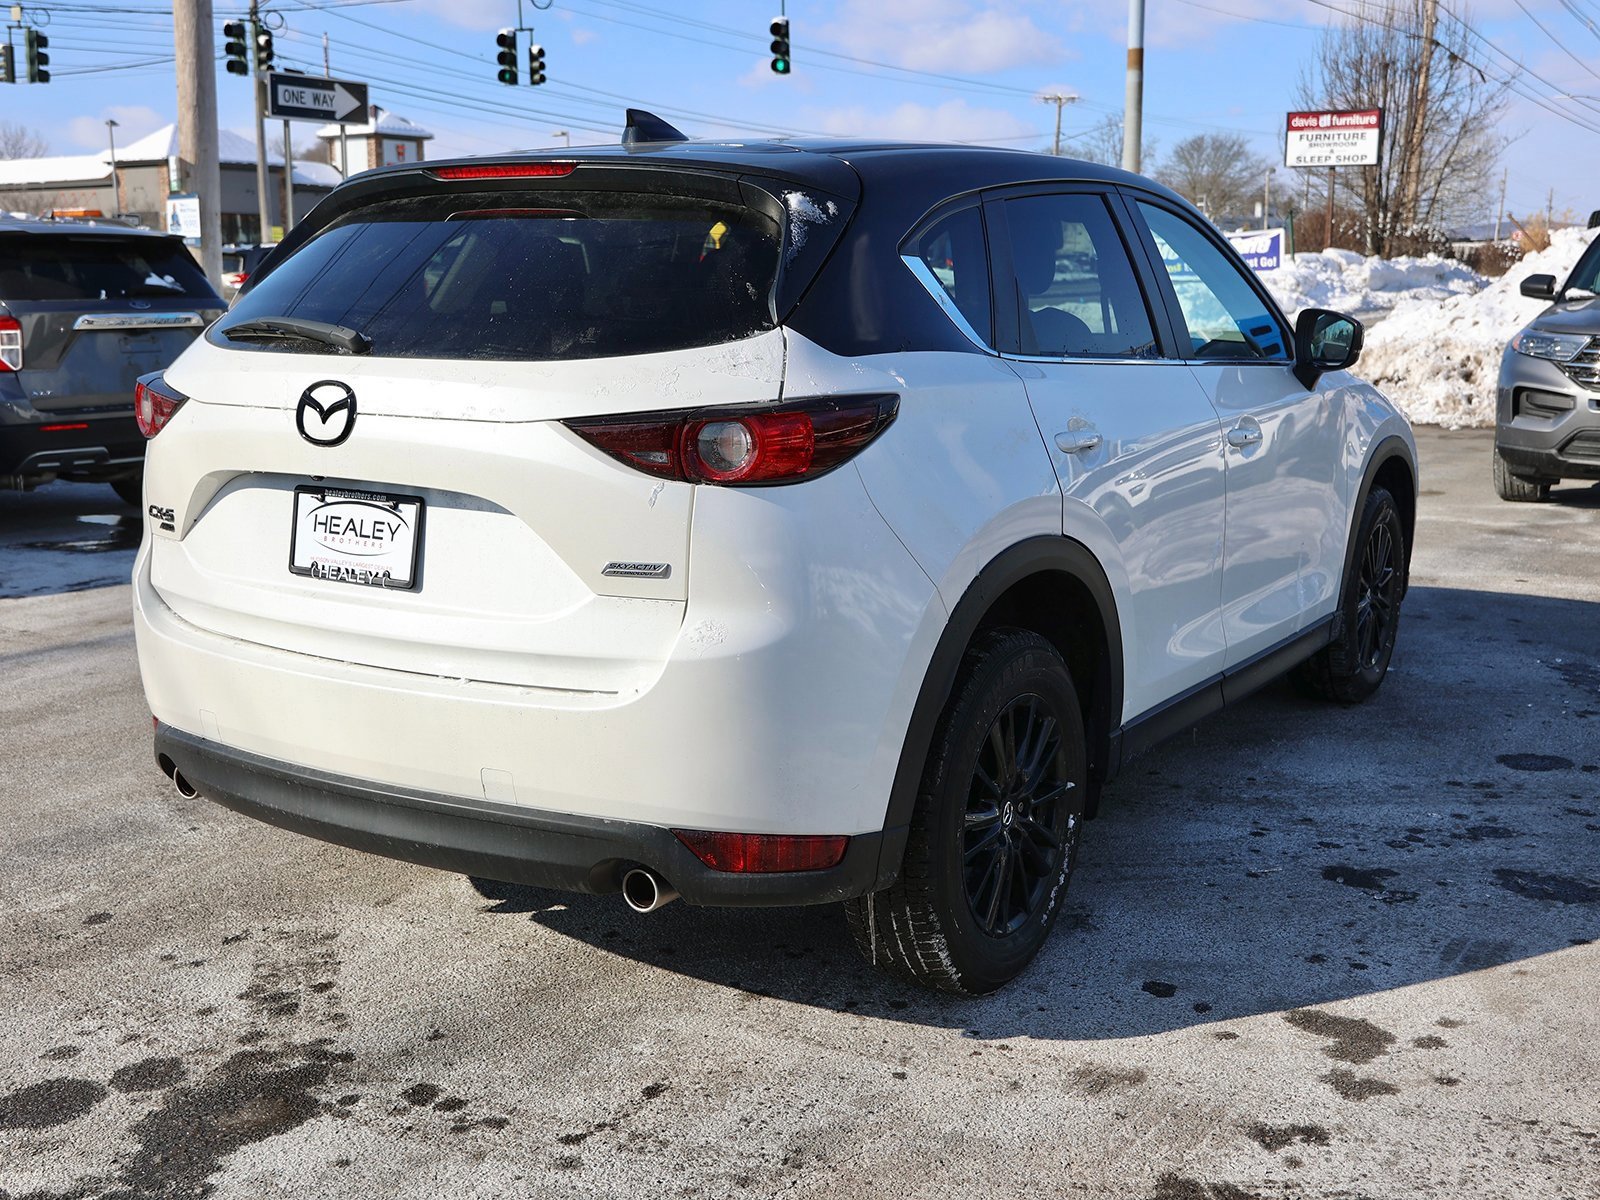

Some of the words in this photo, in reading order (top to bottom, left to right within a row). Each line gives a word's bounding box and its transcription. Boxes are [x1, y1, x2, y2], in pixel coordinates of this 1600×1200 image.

[283, 89, 306, 105] ONE
[312, 91, 336, 108] WAY
[1291, 115, 1318, 127] davis
[1332, 113, 1377, 126] furniture
[1299, 132, 1367, 142] FURNITURE
[1296, 155, 1331, 164] SLEEP
[1335, 154, 1368, 163] SHOP
[1259, 255, 1277, 268] Go!
[324, 489, 387, 501] healeybrothers.com
[313, 513, 401, 542] HEALEY
[323, 536, 383, 548] BROTHERS
[609, 563, 661, 571] SKYACTIV
[319, 564, 375, 585] HEALEY
